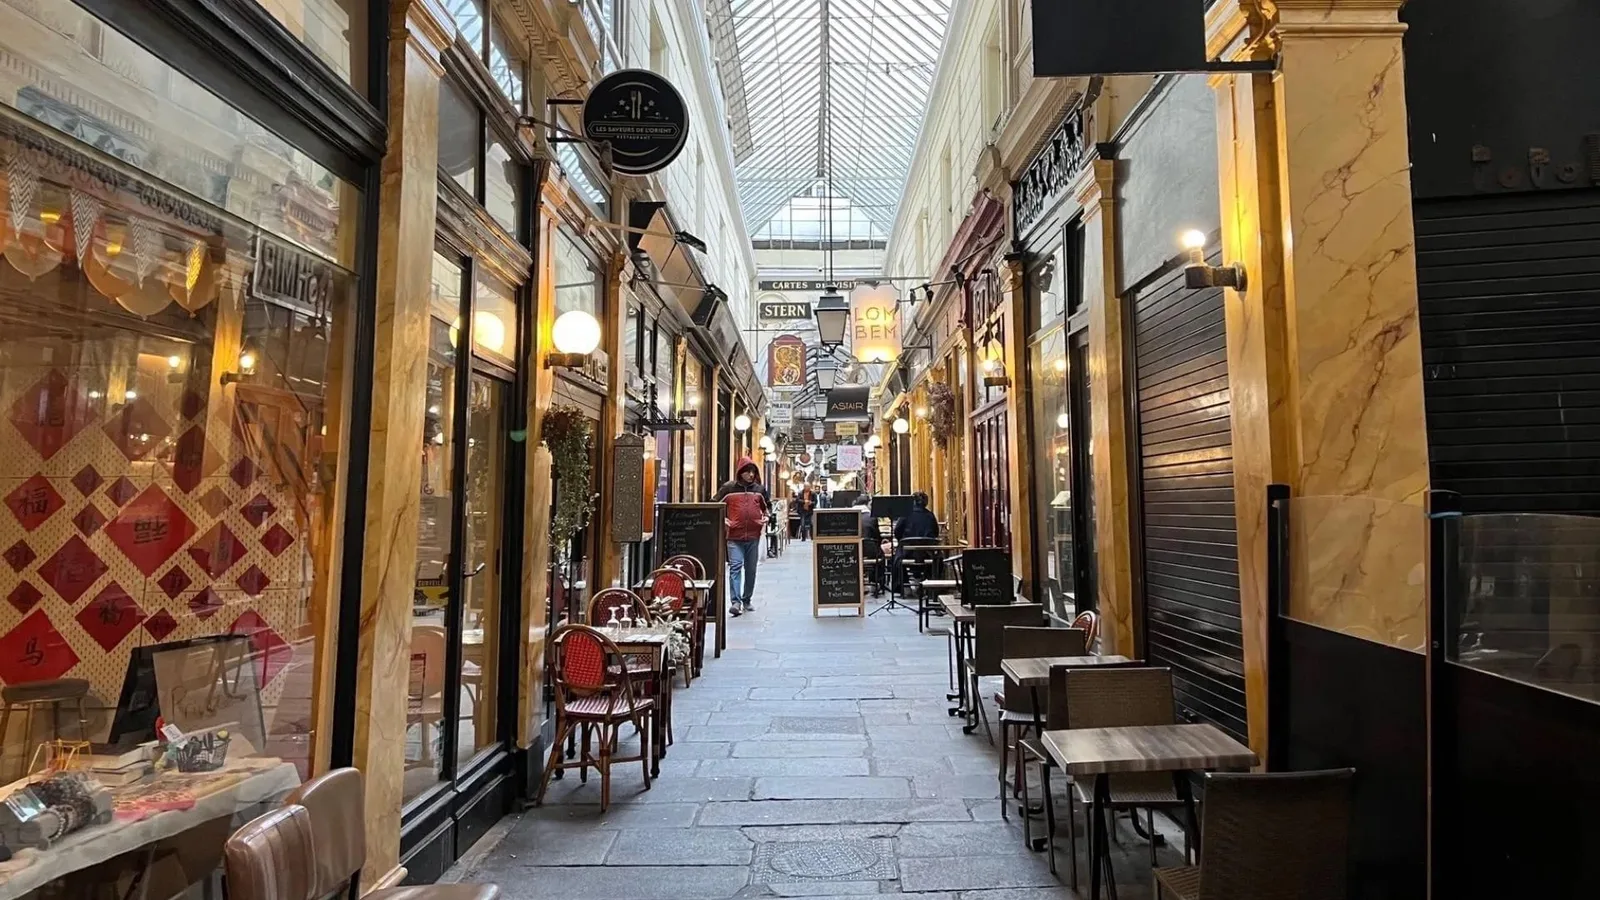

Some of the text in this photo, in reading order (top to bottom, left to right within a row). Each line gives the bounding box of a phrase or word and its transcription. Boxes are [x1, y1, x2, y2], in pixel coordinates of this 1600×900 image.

[772, 281, 808, 289] CARTES
[765, 304, 806, 317] STERN
[854, 306, 896, 321] LOM
[855, 324, 897, 339] BEM
